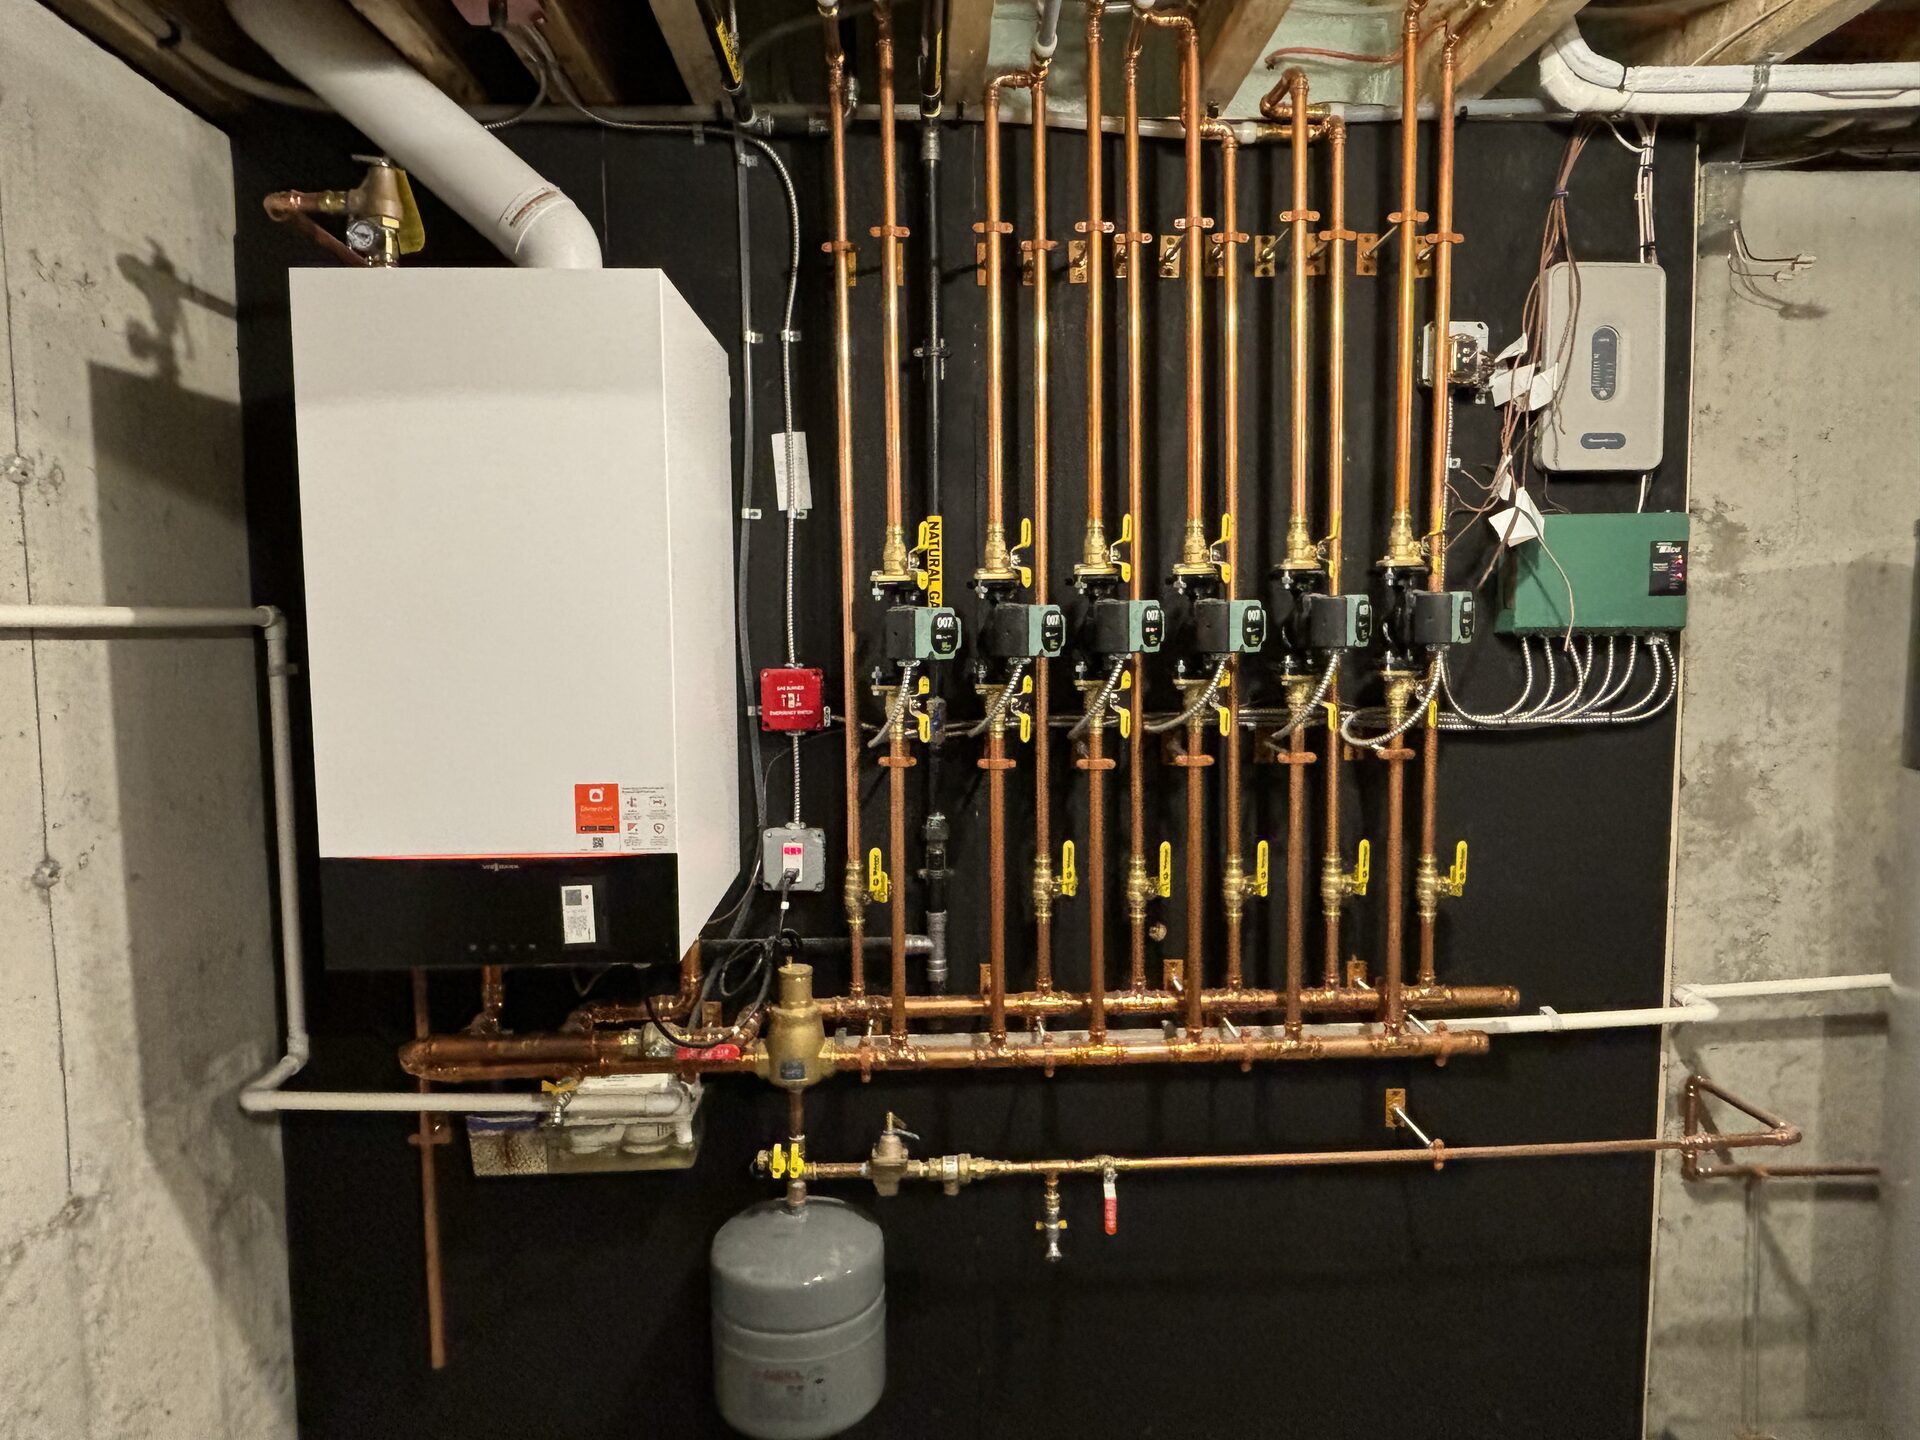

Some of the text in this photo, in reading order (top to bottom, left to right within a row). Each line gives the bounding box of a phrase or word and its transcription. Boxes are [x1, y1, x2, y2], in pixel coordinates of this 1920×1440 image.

[929, 521, 941, 608] NATURAL GA
[1046, 614, 1060, 625] 007
[1146, 610, 1159, 621] 007
[1247, 609, 1260, 621] 007
[937, 617, 953, 628] 007
